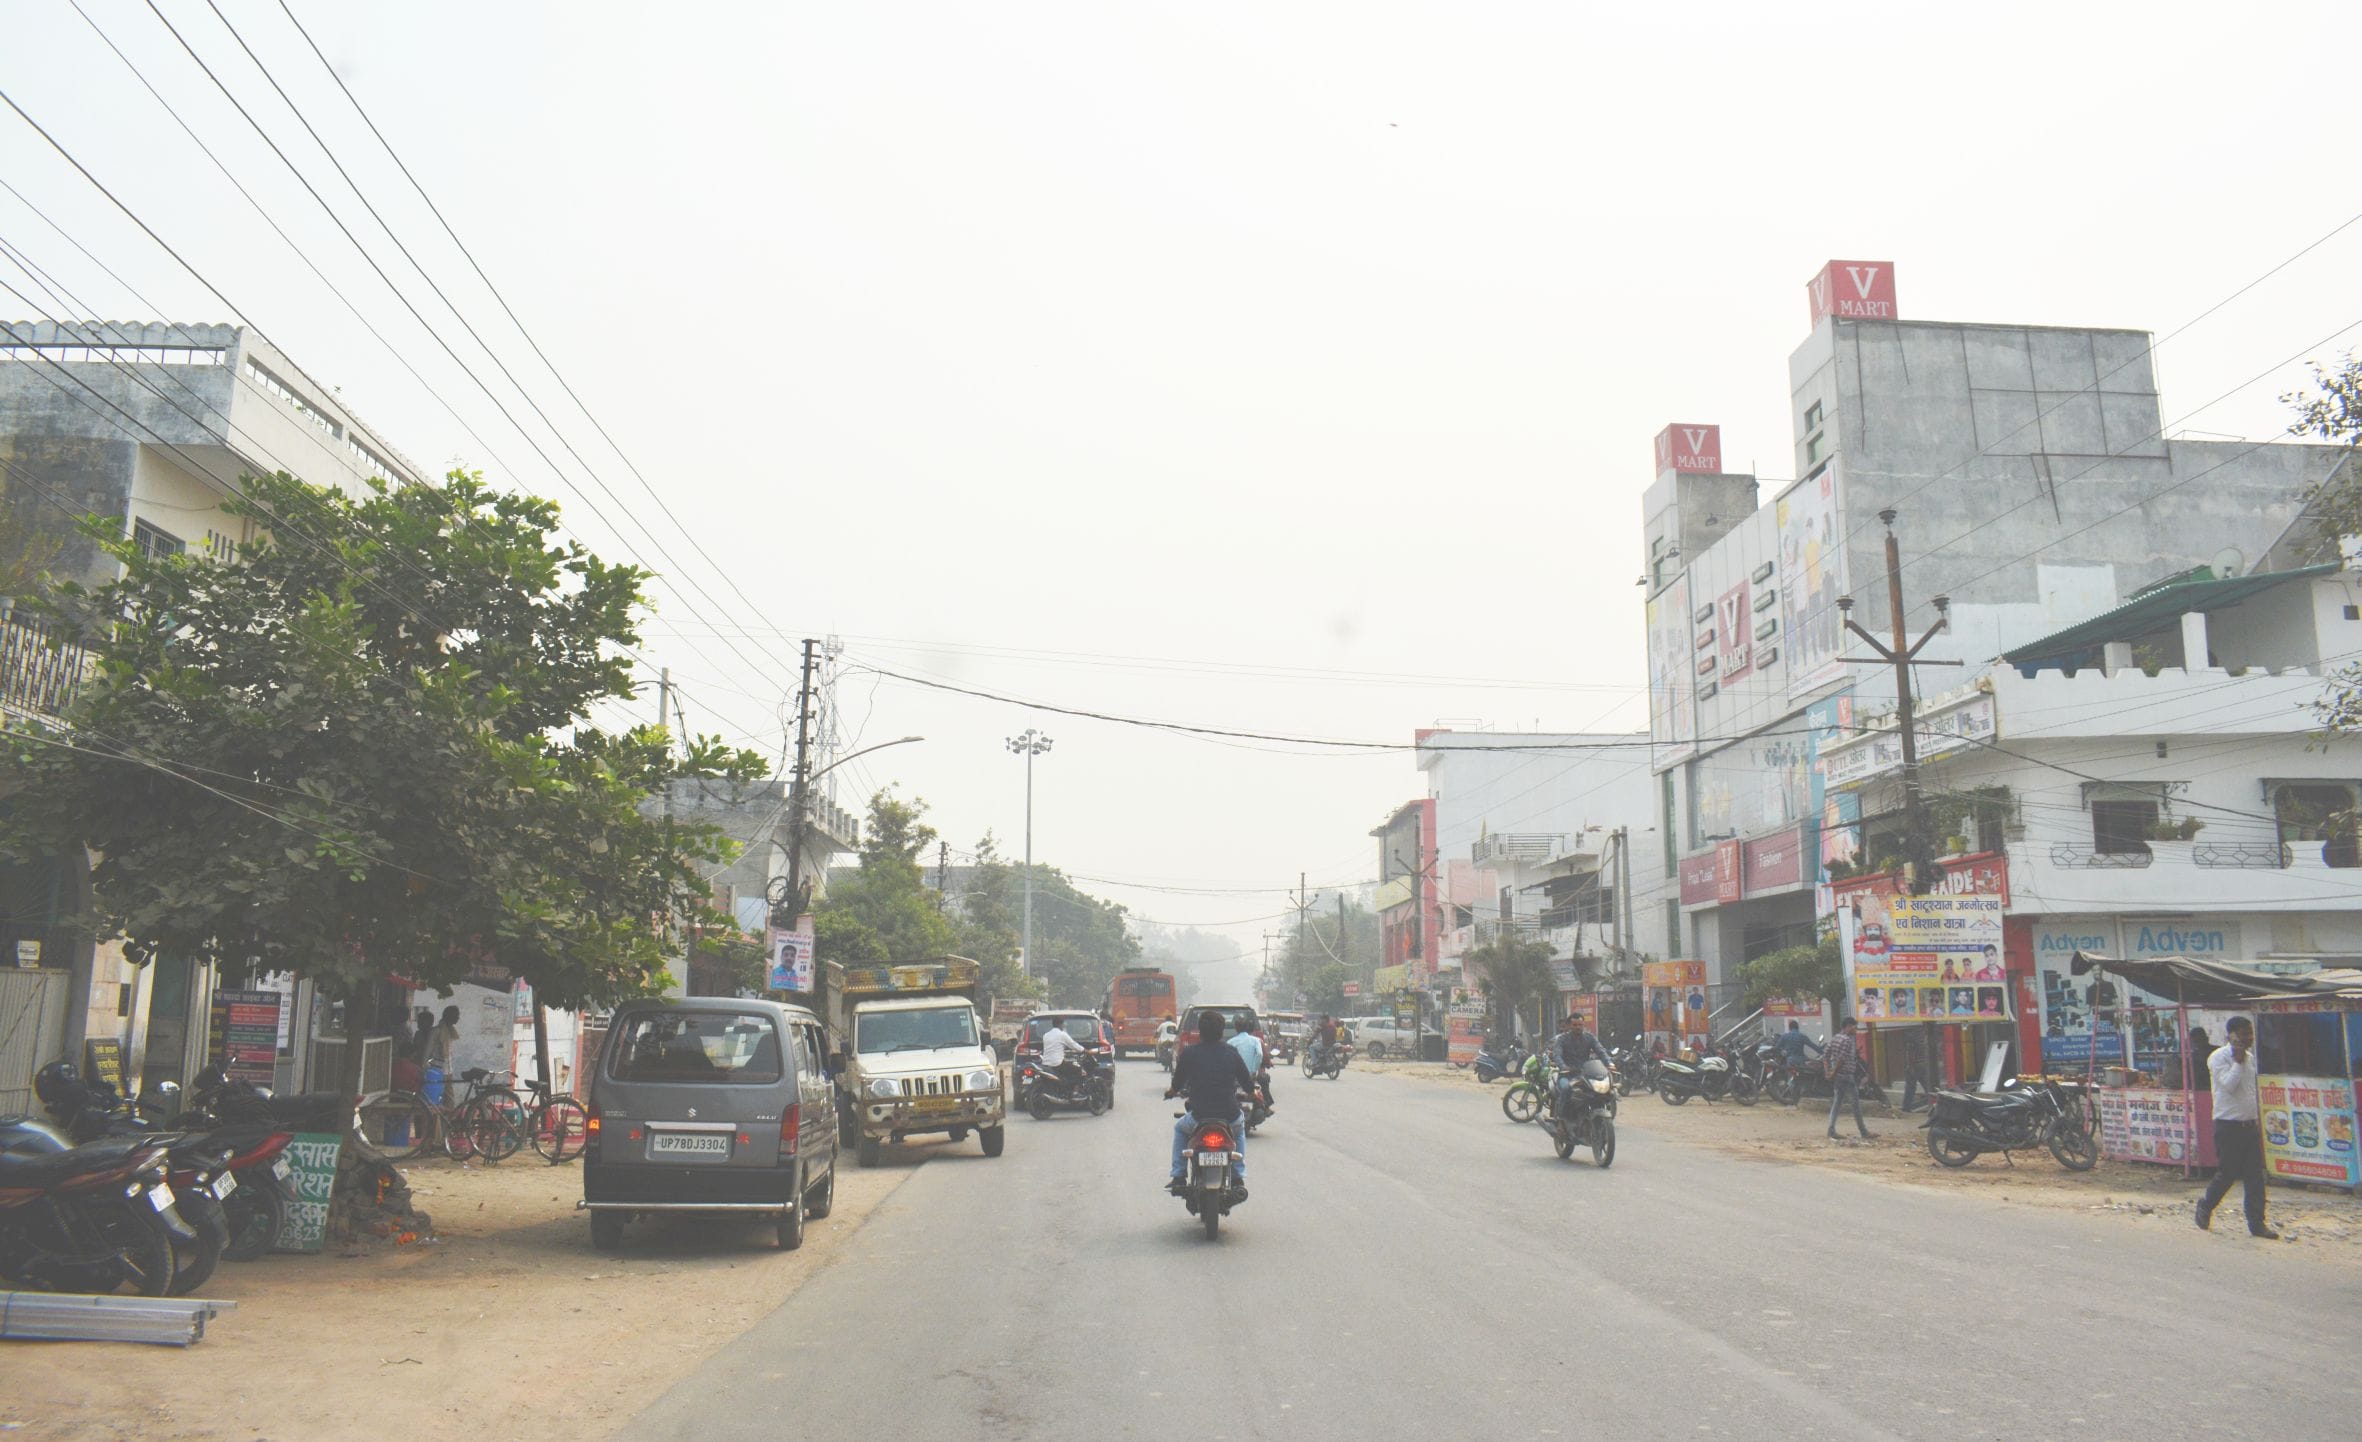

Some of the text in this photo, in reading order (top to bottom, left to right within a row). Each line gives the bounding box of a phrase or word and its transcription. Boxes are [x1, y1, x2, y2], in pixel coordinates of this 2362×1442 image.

[1846, 267, 1878, 299] V
[1840, 300, 1889, 316] MART
[1682, 428, 1708, 456] V
[1678, 456, 1717, 468] MART
[1721, 592, 1742, 647] V
[1720, 847, 1732, 880] V
[1896, 897, 1906, 911] श्री
[1955, 898, 1999, 911] जन्मोत्सव
[1896, 915, 1966, 929] एवं निशान यात्रा
[2128, 1098, 2160, 1110] मनोज
[661, 1138, 726, 1150] UP78DJ3304
